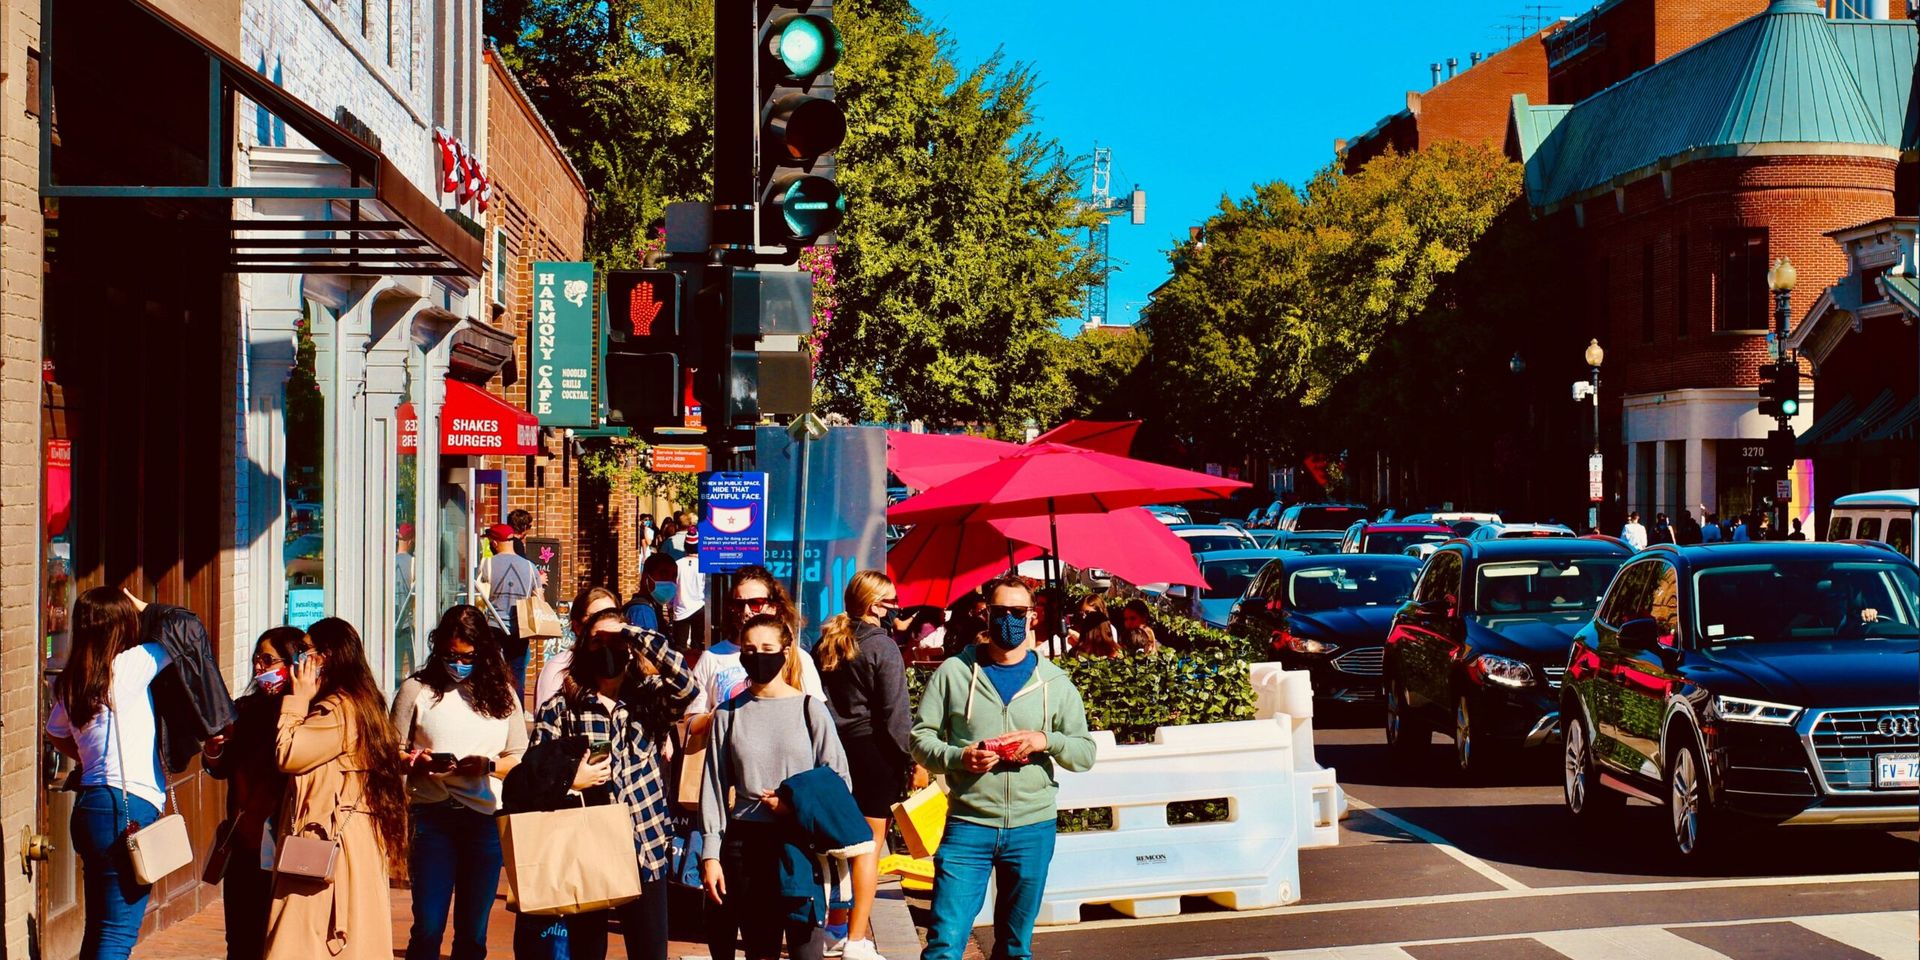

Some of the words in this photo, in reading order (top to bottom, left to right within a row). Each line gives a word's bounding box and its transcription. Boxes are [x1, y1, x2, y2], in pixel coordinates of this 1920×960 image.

[538, 273, 556, 360] HARMONY
[562, 368, 587, 378] NOODLES
[537, 365, 554, 414] CAFE
[562, 379, 581, 389] GRILLS
[562, 390, 589, 400] COCKTAIL
[452, 418, 498, 433] SHAKES
[447, 434, 502, 447] BURGERS
[1742, 447, 1764, 456] 3270
[1882, 764, 1897, 779] FV
